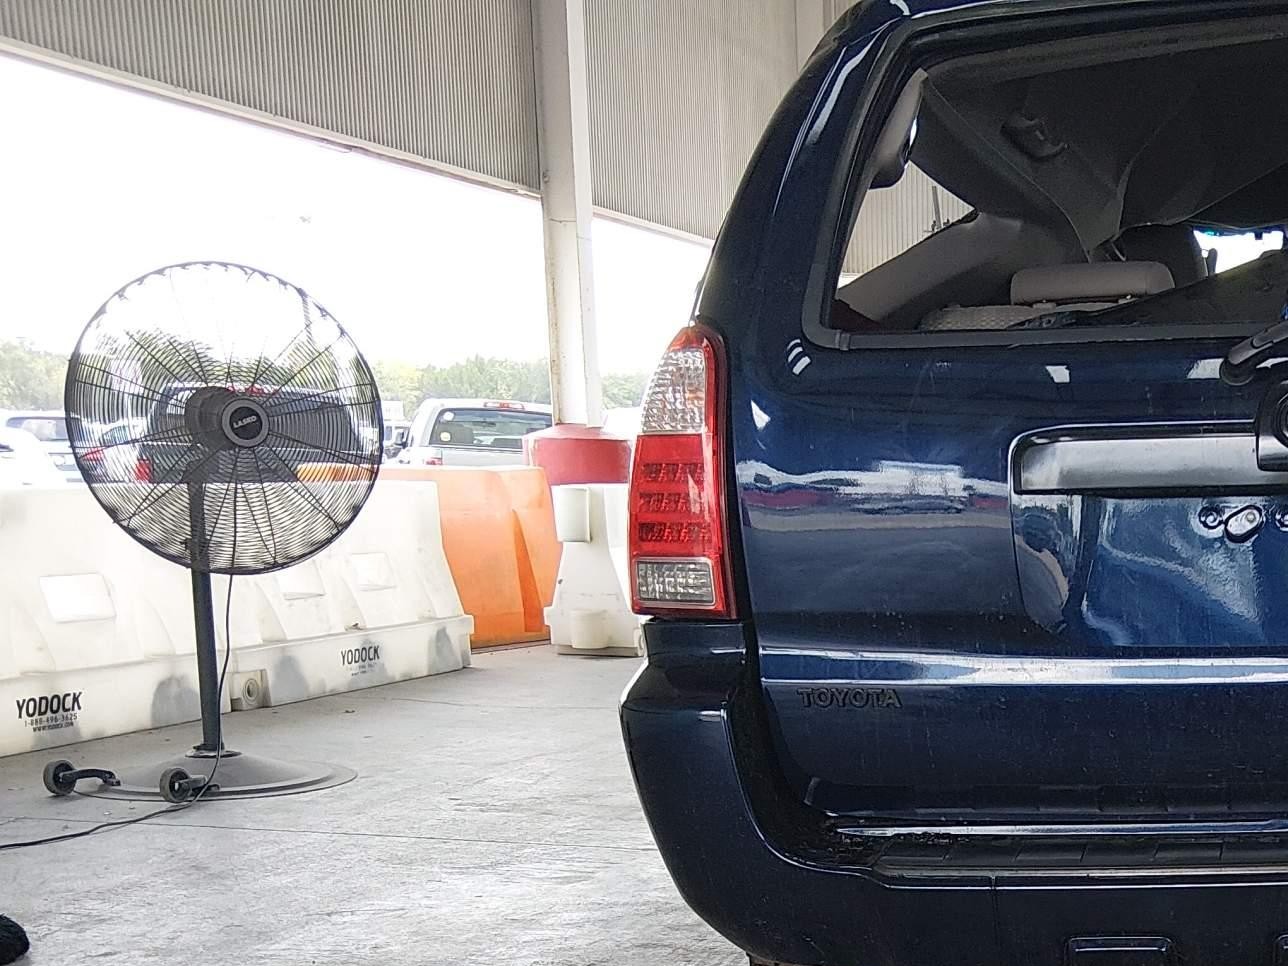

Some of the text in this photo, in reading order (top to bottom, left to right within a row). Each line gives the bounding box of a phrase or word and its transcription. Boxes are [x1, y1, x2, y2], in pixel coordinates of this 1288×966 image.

[340, 645, 380, 666] YODOCK
[16, 692, 82, 719] YODOCK
[797, 687, 903, 709] TOYOTA
